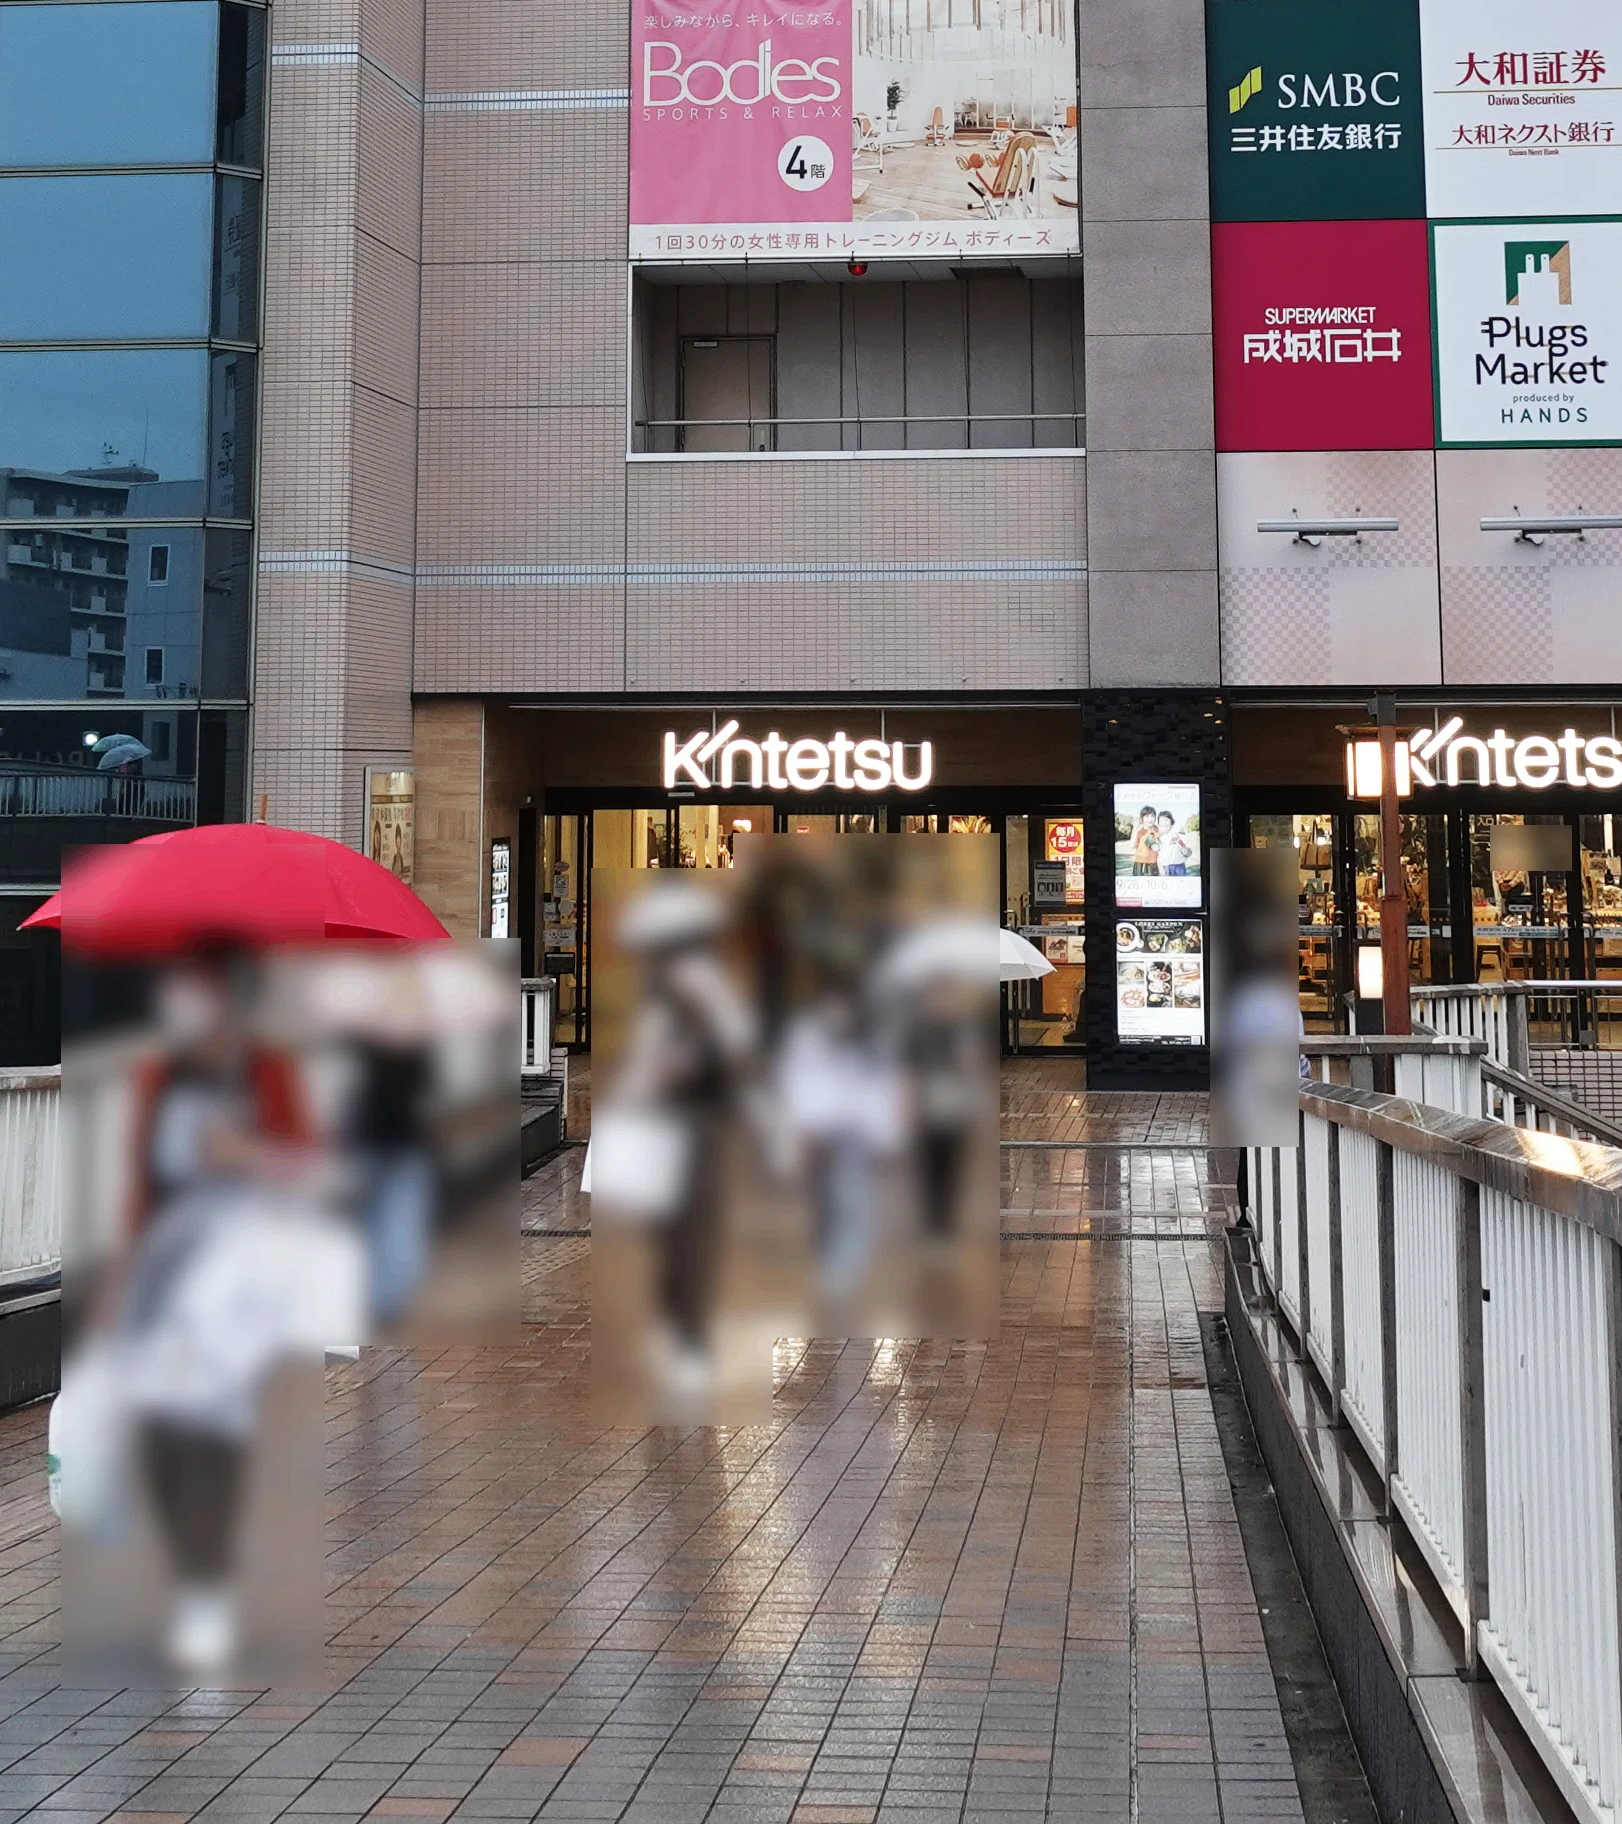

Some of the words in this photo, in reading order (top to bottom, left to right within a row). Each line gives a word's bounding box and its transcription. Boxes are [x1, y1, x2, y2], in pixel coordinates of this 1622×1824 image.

[643, 12, 842, 30] 楽しみながら、キレイになる。
[643, 38, 842, 107] Bodies
[1454, 49, 1607, 87] 大和証券
[1277, 71, 1401, 109] SMBC
[1487, 93, 1520, 106] Daiwa
[1522, 93, 1576, 106] Securities
[642, 107, 728, 122] SPORTS
[743, 107, 754, 120] &
[771, 106, 842, 119] RELAX
[1230, 123, 1402, 153] 三井住友銀行
[1451, 121, 1615, 147] 大和ネクスト銀行
[785, 145, 826, 180] 4階
[654, 231, 958, 251] 1回30分の女性専用トレーニングジム
[965, 229, 1052, 248] ボディーズ
[1264, 306, 1377, 326] SUPERMARKET
[1242, 327, 1402, 364] 成城石井
[1481, 316, 1589, 357] Plugs
[1475, 353, 1608, 386] Market
[1512, 393, 1560, 404] produced
[1561, 393, 1575, 405] by
[1500, 407, 1589, 424] HANDS
[663, 719, 933, 790] Kintetsu
